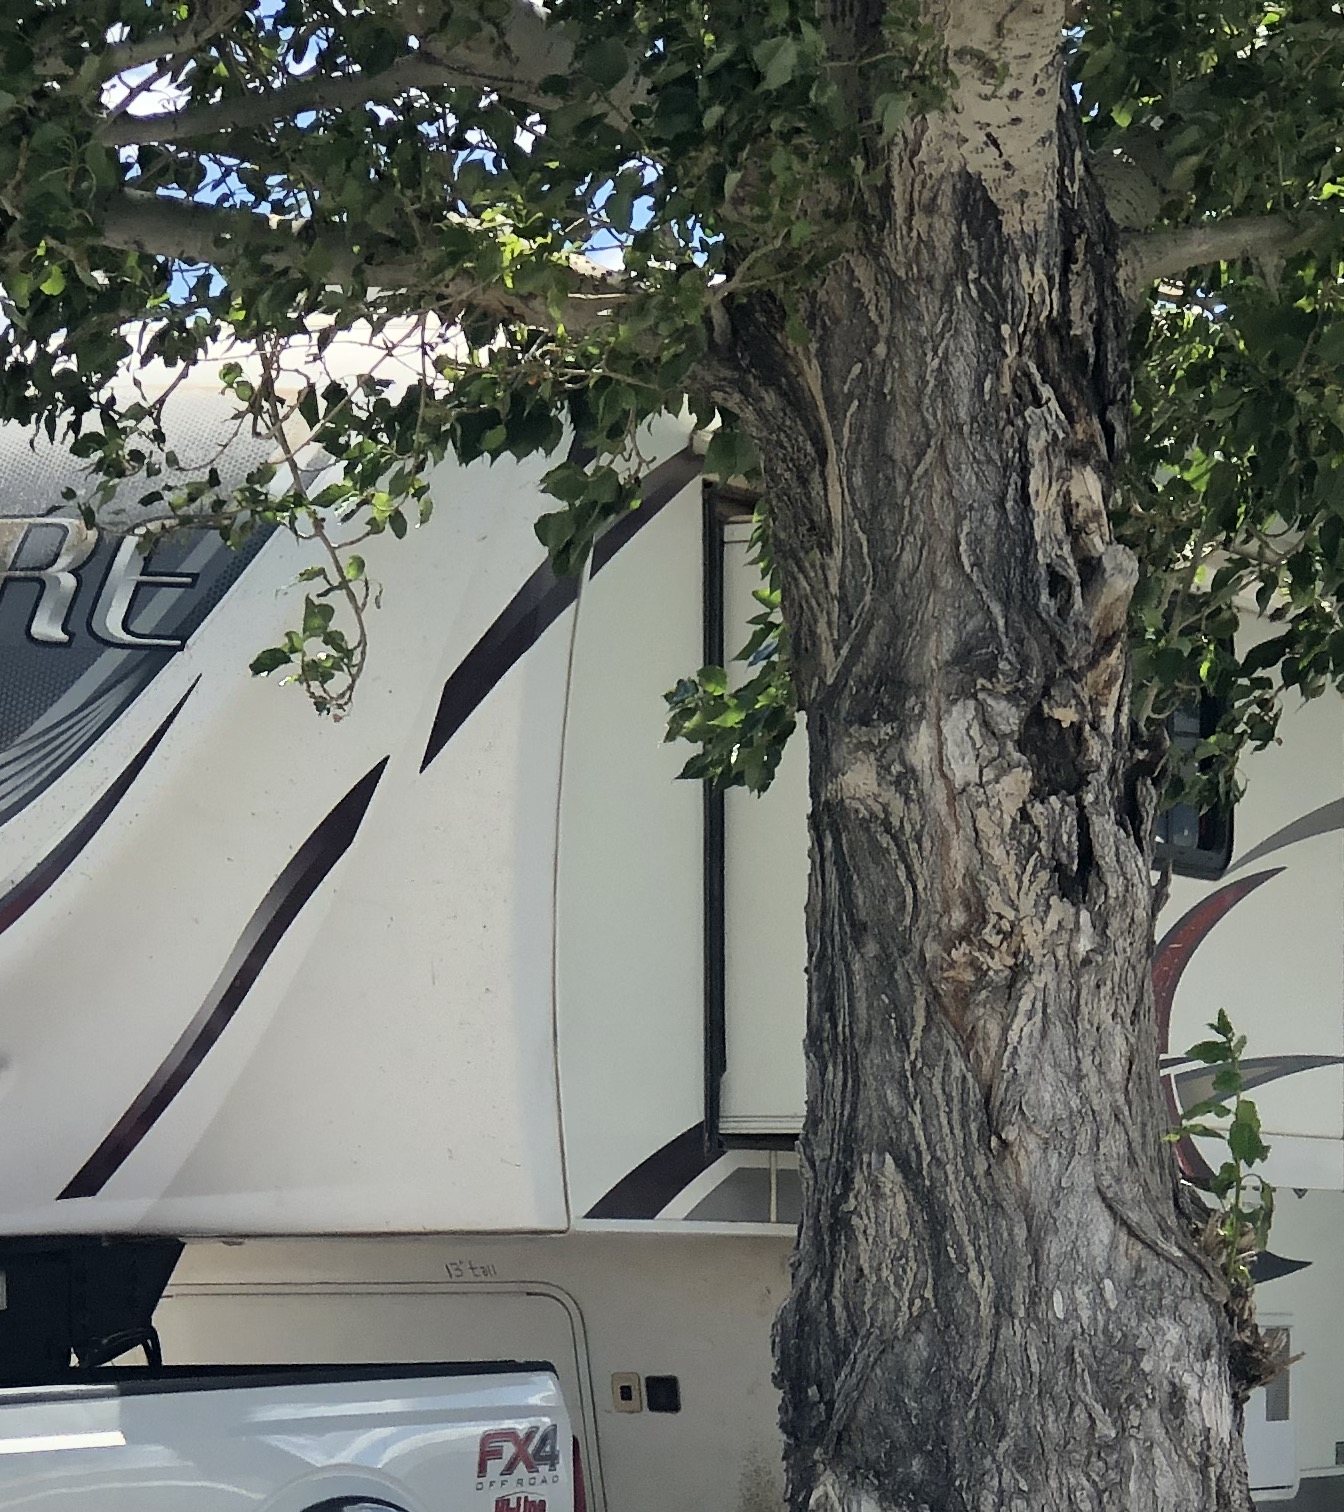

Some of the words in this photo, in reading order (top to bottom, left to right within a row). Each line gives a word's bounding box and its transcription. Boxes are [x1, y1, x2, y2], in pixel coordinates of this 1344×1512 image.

[468, 1260, 497, 1278] tall
[477, 1424, 560, 1479] FX4
[475, 1480, 509, 1491] OFF
[515, 1474, 560, 1488] ROAD
